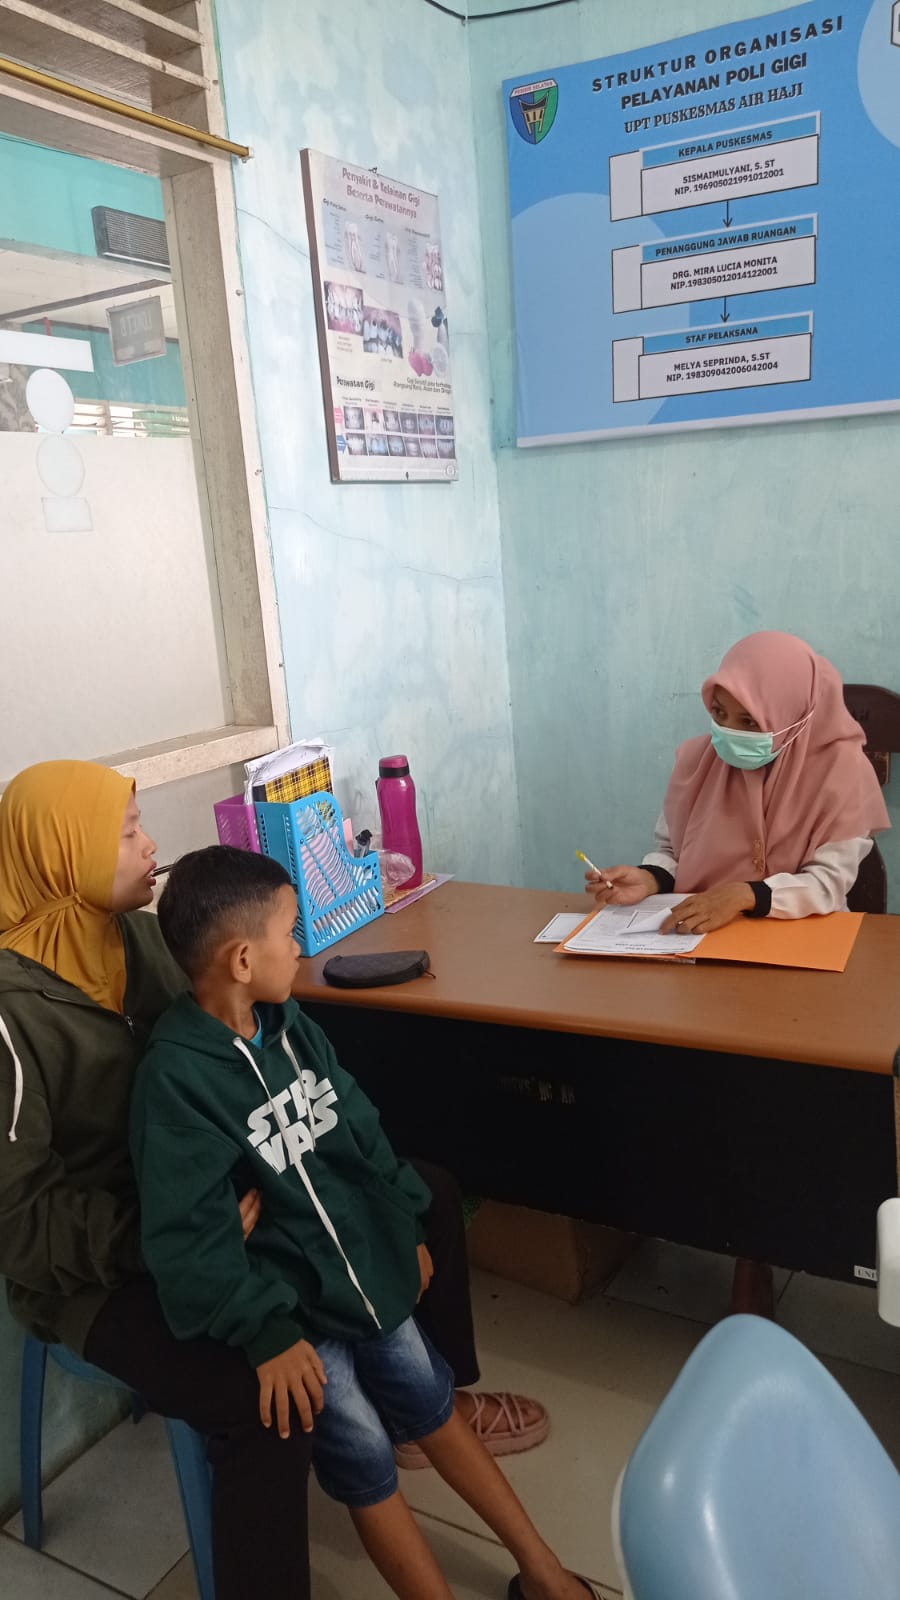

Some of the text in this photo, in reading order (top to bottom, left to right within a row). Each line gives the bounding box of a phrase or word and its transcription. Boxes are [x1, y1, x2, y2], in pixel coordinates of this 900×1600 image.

[592, 16, 843, 91] STRUKTUR ORGANISASI
[621, 52, 807, 110] PELAYANAN POLI GIGI
[624, 82, 804, 134] UPT PUSKESMAS AIR HAJI
[678, 130, 773, 158] KEPALA PUSKESMAS
[682, 159, 776, 184] SISMAIMULYANI, S. ST
[342, 167, 421, 208] Penyakit & Kelainan Gigi
[346, 184, 374, 203] Beserta
[374, 194, 417, 219] Perawatannya
[655, 225, 797, 257] PENANGGUNG JAWAB RUANGAN
[672, 256, 778, 280] DRG. MIRA LUCIA MONITA
[685, 326, 759, 344] STAF PELAKSANA
[673, 352, 770, 372] MELYA SEPRINDA, S.ST
[364, 380, 376, 391] Gigi
